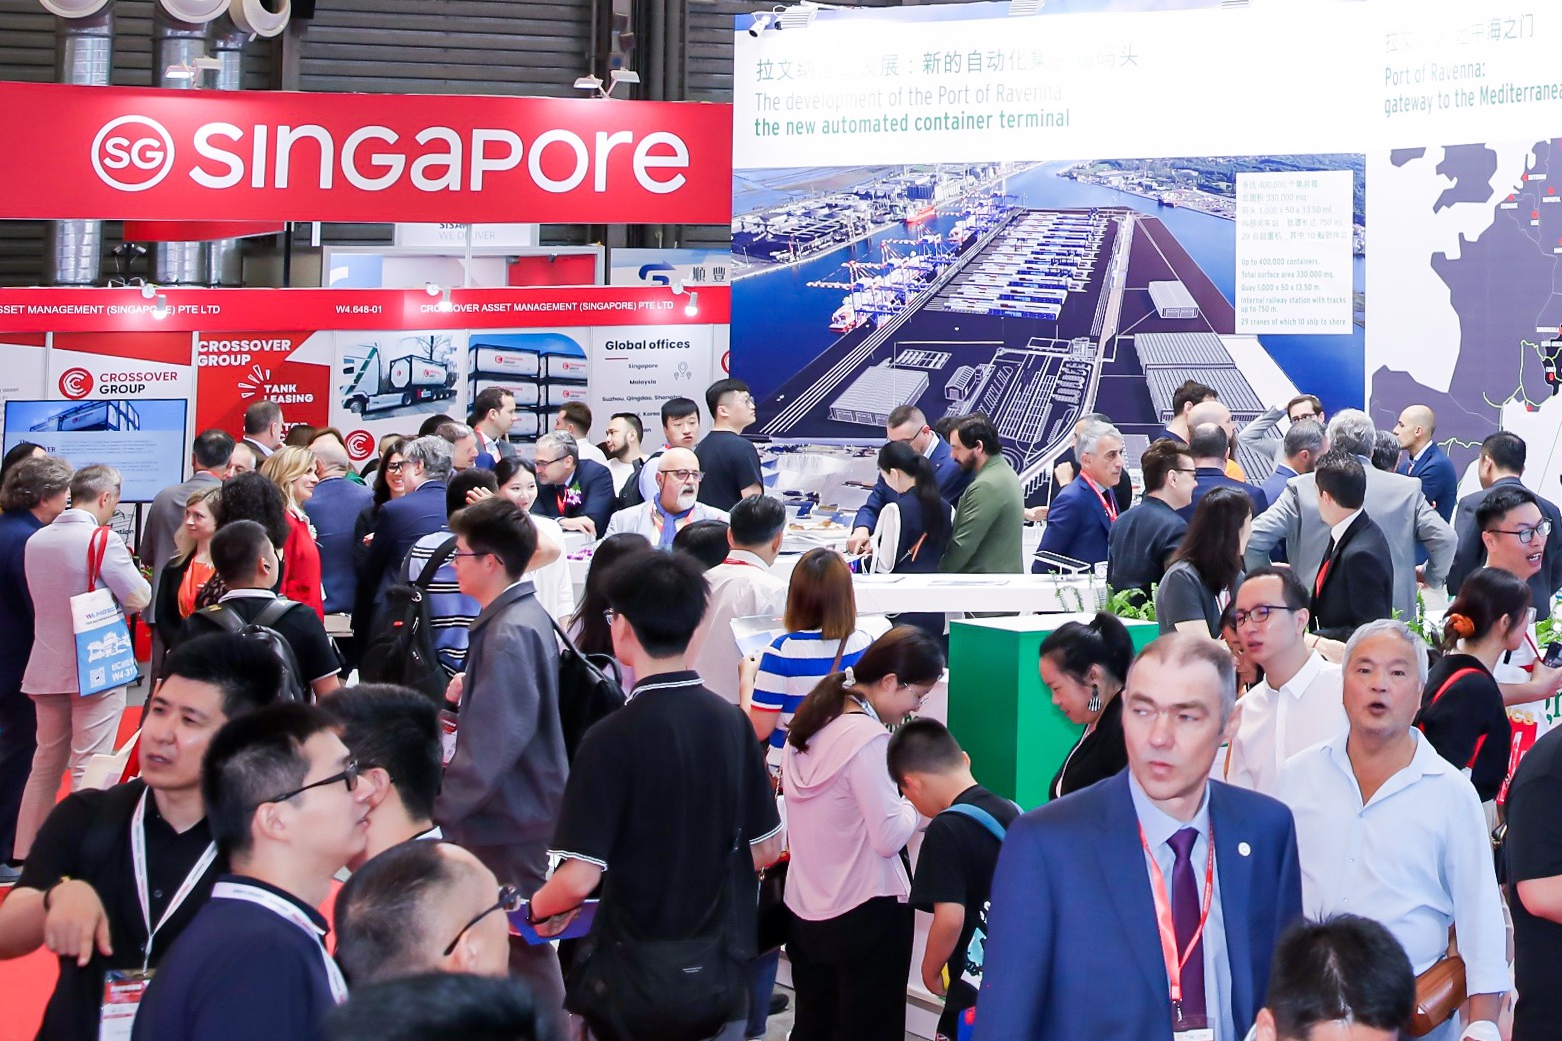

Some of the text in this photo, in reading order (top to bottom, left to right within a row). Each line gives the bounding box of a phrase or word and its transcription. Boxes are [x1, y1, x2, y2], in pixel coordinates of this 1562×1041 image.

[1385, 61, 1486, 86] Port of Ravenna:
[755, 92, 780, 111] The
[786, 90, 882, 113] development
[888, 87, 902, 106] of
[908, 87, 932, 106] the
[938, 85, 969, 105] Port
[976, 84, 991, 103] of
[1384, 94, 1433, 118] gateway
[1438, 90, 1451, 110] to
[1455, 88, 1475, 108] the
[755, 108, 1071, 137] the new automated container terminal
[102, 136, 164, 171] SG
[1241, 258, 1250, 266] Up
[1251, 258, 1258, 266] to
[1241, 270, 1256, 278] Total
[1257, 270, 1280, 278] surface
[1240, 284, 1256, 292] Quay
[1241, 296, 1346, 305] Internal railway station with tracks
[27, 305, 104, 315] MANAGEMENT
[178, 305, 199, 314] PTE
[200, 305, 221, 314] LTD
[336, 305, 383, 314] W4.648-01
[481, 303, 512, 312] ASSET
[513, 302, 578, 312] MANAGEMENT
[579, 302, 638, 312] (SINGAPORE)
[638, 301, 655, 311] PTE
[657, 301, 675, 310] LTD
[1240, 306, 1249, 314] up
[1271, 318, 1278, 326] of
[1279, 318, 1297, 326] which
[1298, 318, 1305, 326] 10
[1306, 318, 1319, 327] ship
[1320, 318, 1328, 326] to
[1329, 318, 1346, 326] shore
[198, 339, 291, 352] CROSSOVER
[605, 338, 690, 351] Global offices
[198, 354, 251, 366] GROUP
[100, 371, 178, 383] CROSSOVER
[100, 384, 146, 394] GROUP
[264, 384, 297, 393] TANK
